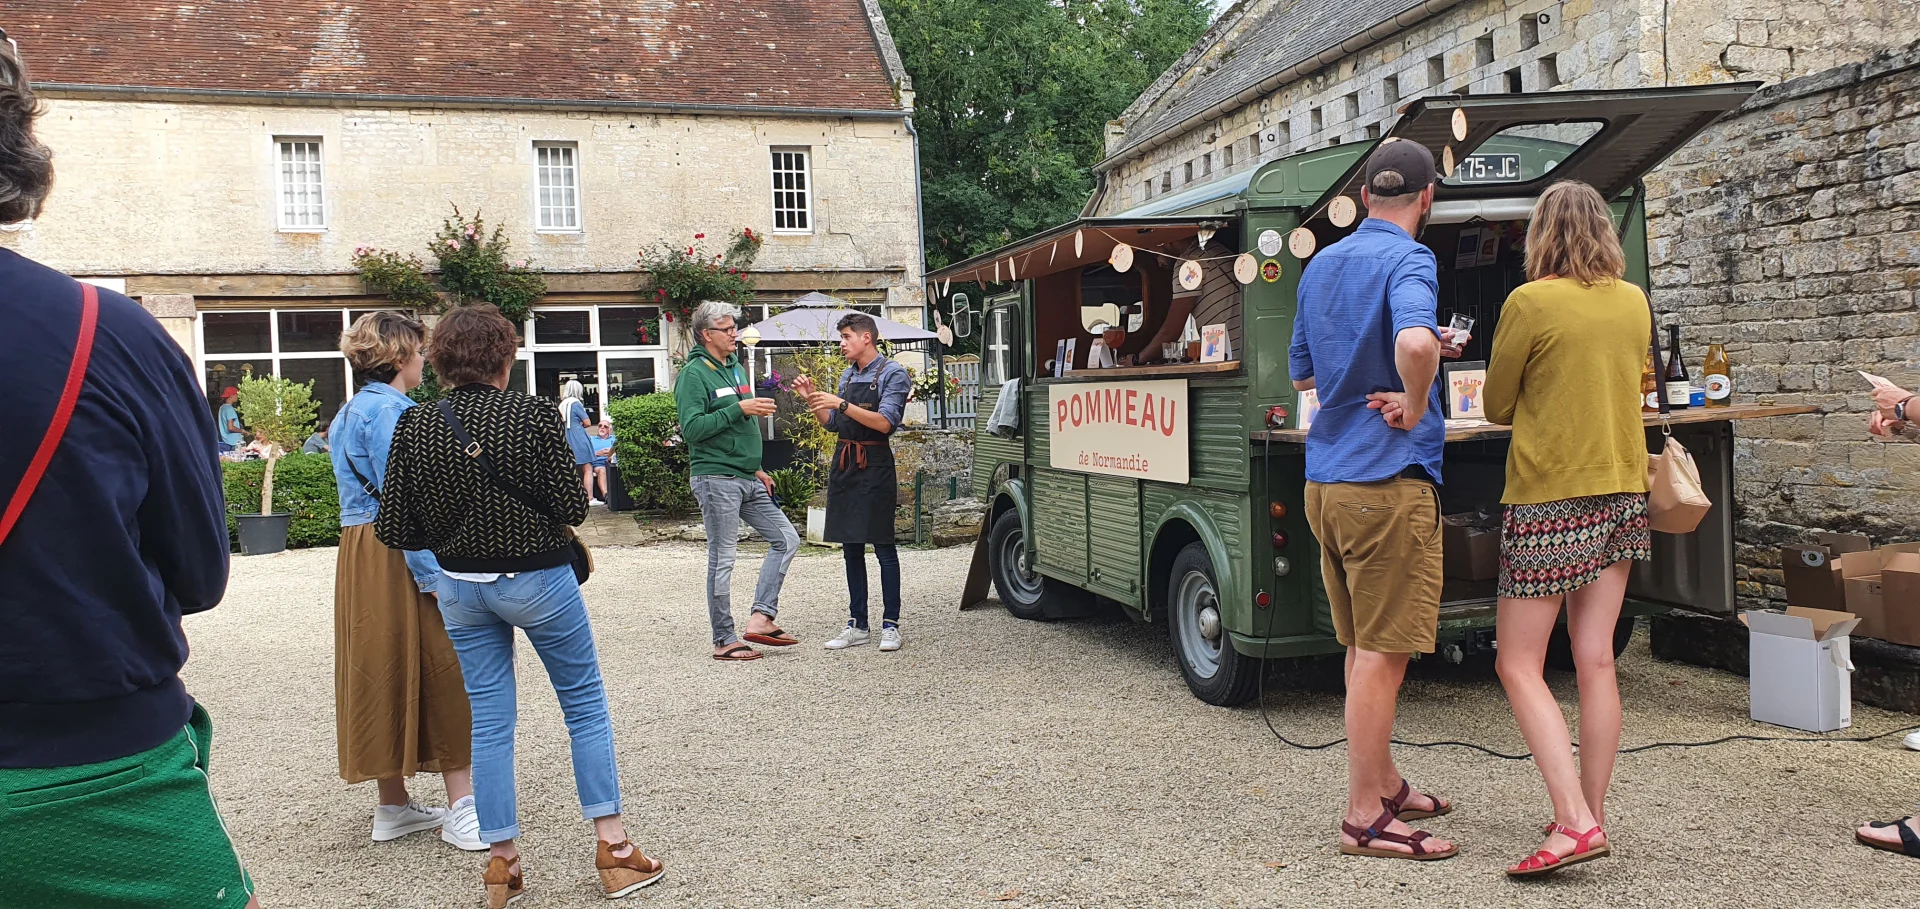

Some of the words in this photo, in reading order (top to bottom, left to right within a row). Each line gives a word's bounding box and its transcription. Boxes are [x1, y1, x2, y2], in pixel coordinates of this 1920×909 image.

[1464, 157, 1516, 179] 75-JC
[1057, 388, 1176, 437] POMMEAU
[1078, 450, 1089, 466] de
[1092, 452, 1149, 472] Normandie
